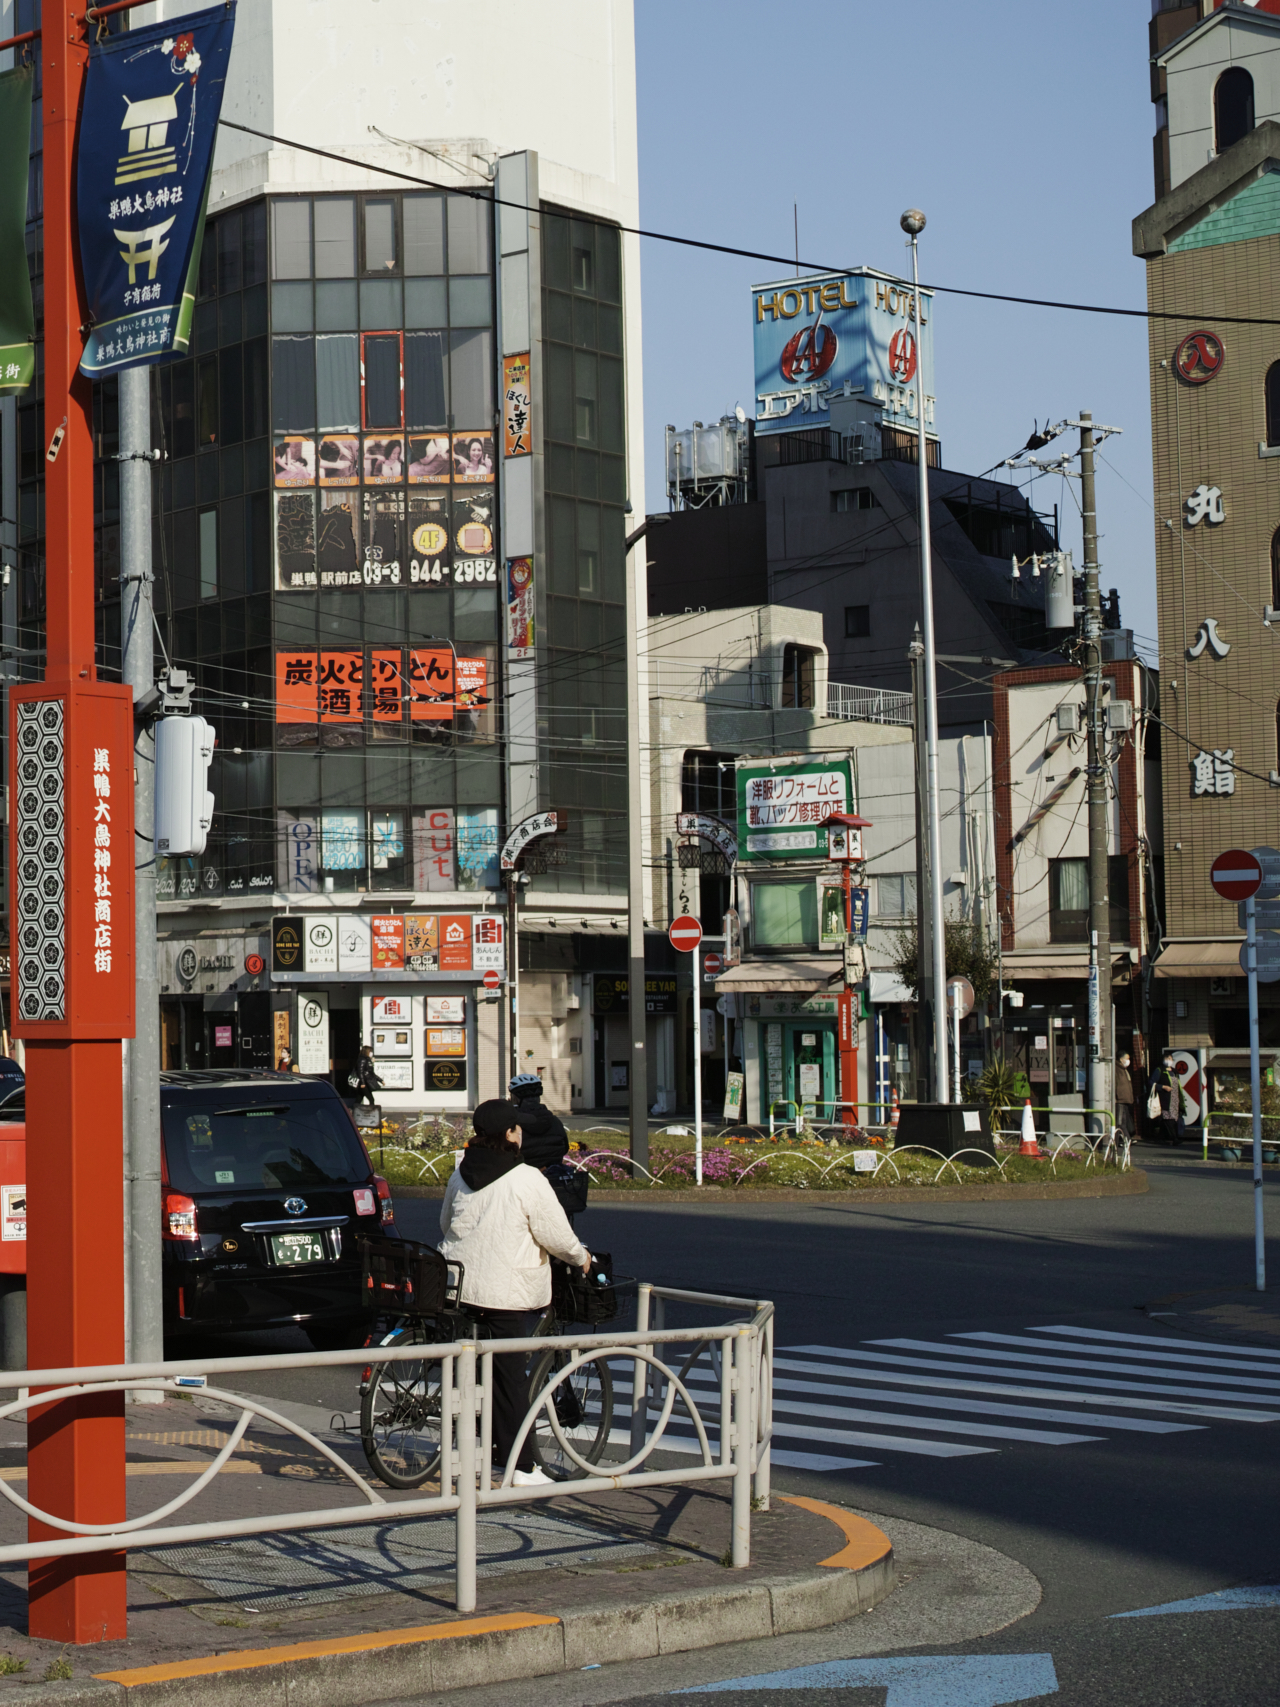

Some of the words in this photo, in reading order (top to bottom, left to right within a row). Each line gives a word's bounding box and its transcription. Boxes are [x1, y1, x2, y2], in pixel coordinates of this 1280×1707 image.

[757, 281, 858, 322] HOTEL
[875, 281, 928, 326] HOTEL
[873, 379, 936, 425] AIRPOT
[419, 530, 440, 549] 4F
[516, 649, 528, 658] 2F
[284, 657, 449, 687] 炭火とりとん
[320, 686, 400, 716] 酒場
[751, 774, 840, 802] 洋服リフォームと
[93, 748, 113, 973] 巣鴨大鳥神社商店街
[292, 823, 313, 893] OPEN
[658, 981, 676, 992] YAR
